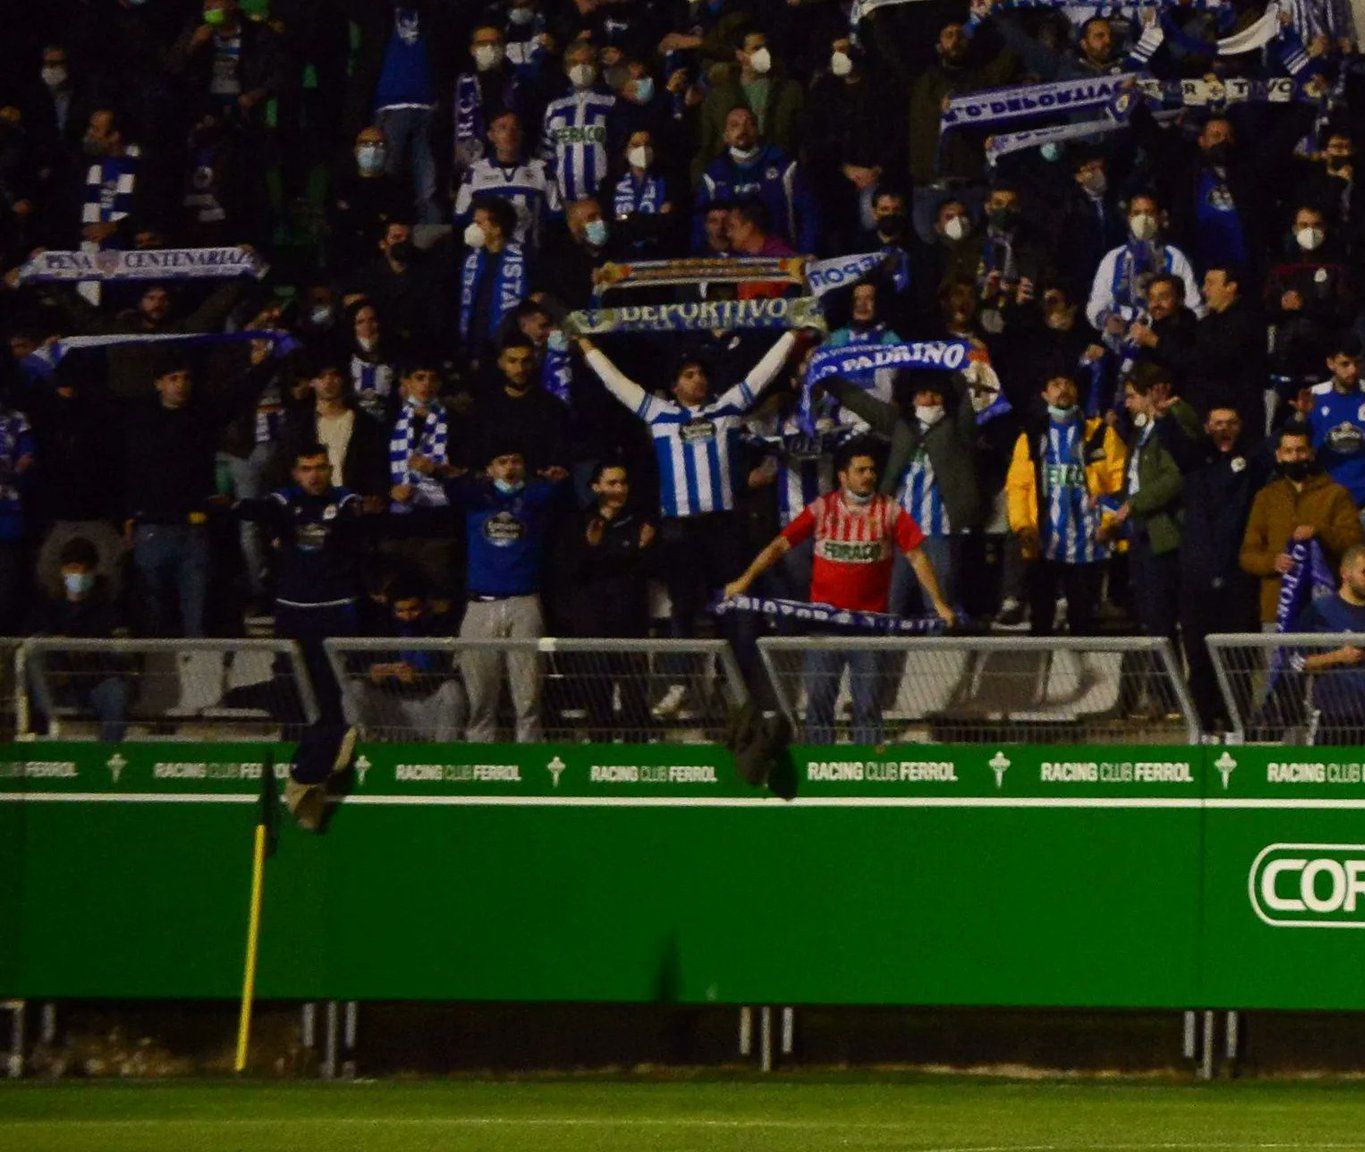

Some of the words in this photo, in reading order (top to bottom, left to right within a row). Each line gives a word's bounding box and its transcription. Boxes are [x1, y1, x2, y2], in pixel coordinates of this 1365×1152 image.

[474, 765, 521, 781] FERROL
[591, 765, 638, 781] RACING
[669, 766, 717, 782] FERROL
[807, 761, 863, 780] RACING
[899, 762, 957, 782] FERROL
[1041, 762, 1098, 781] RACING
[1134, 762, 1193, 782] FERROL
[1267, 763, 1325, 782] RACING
